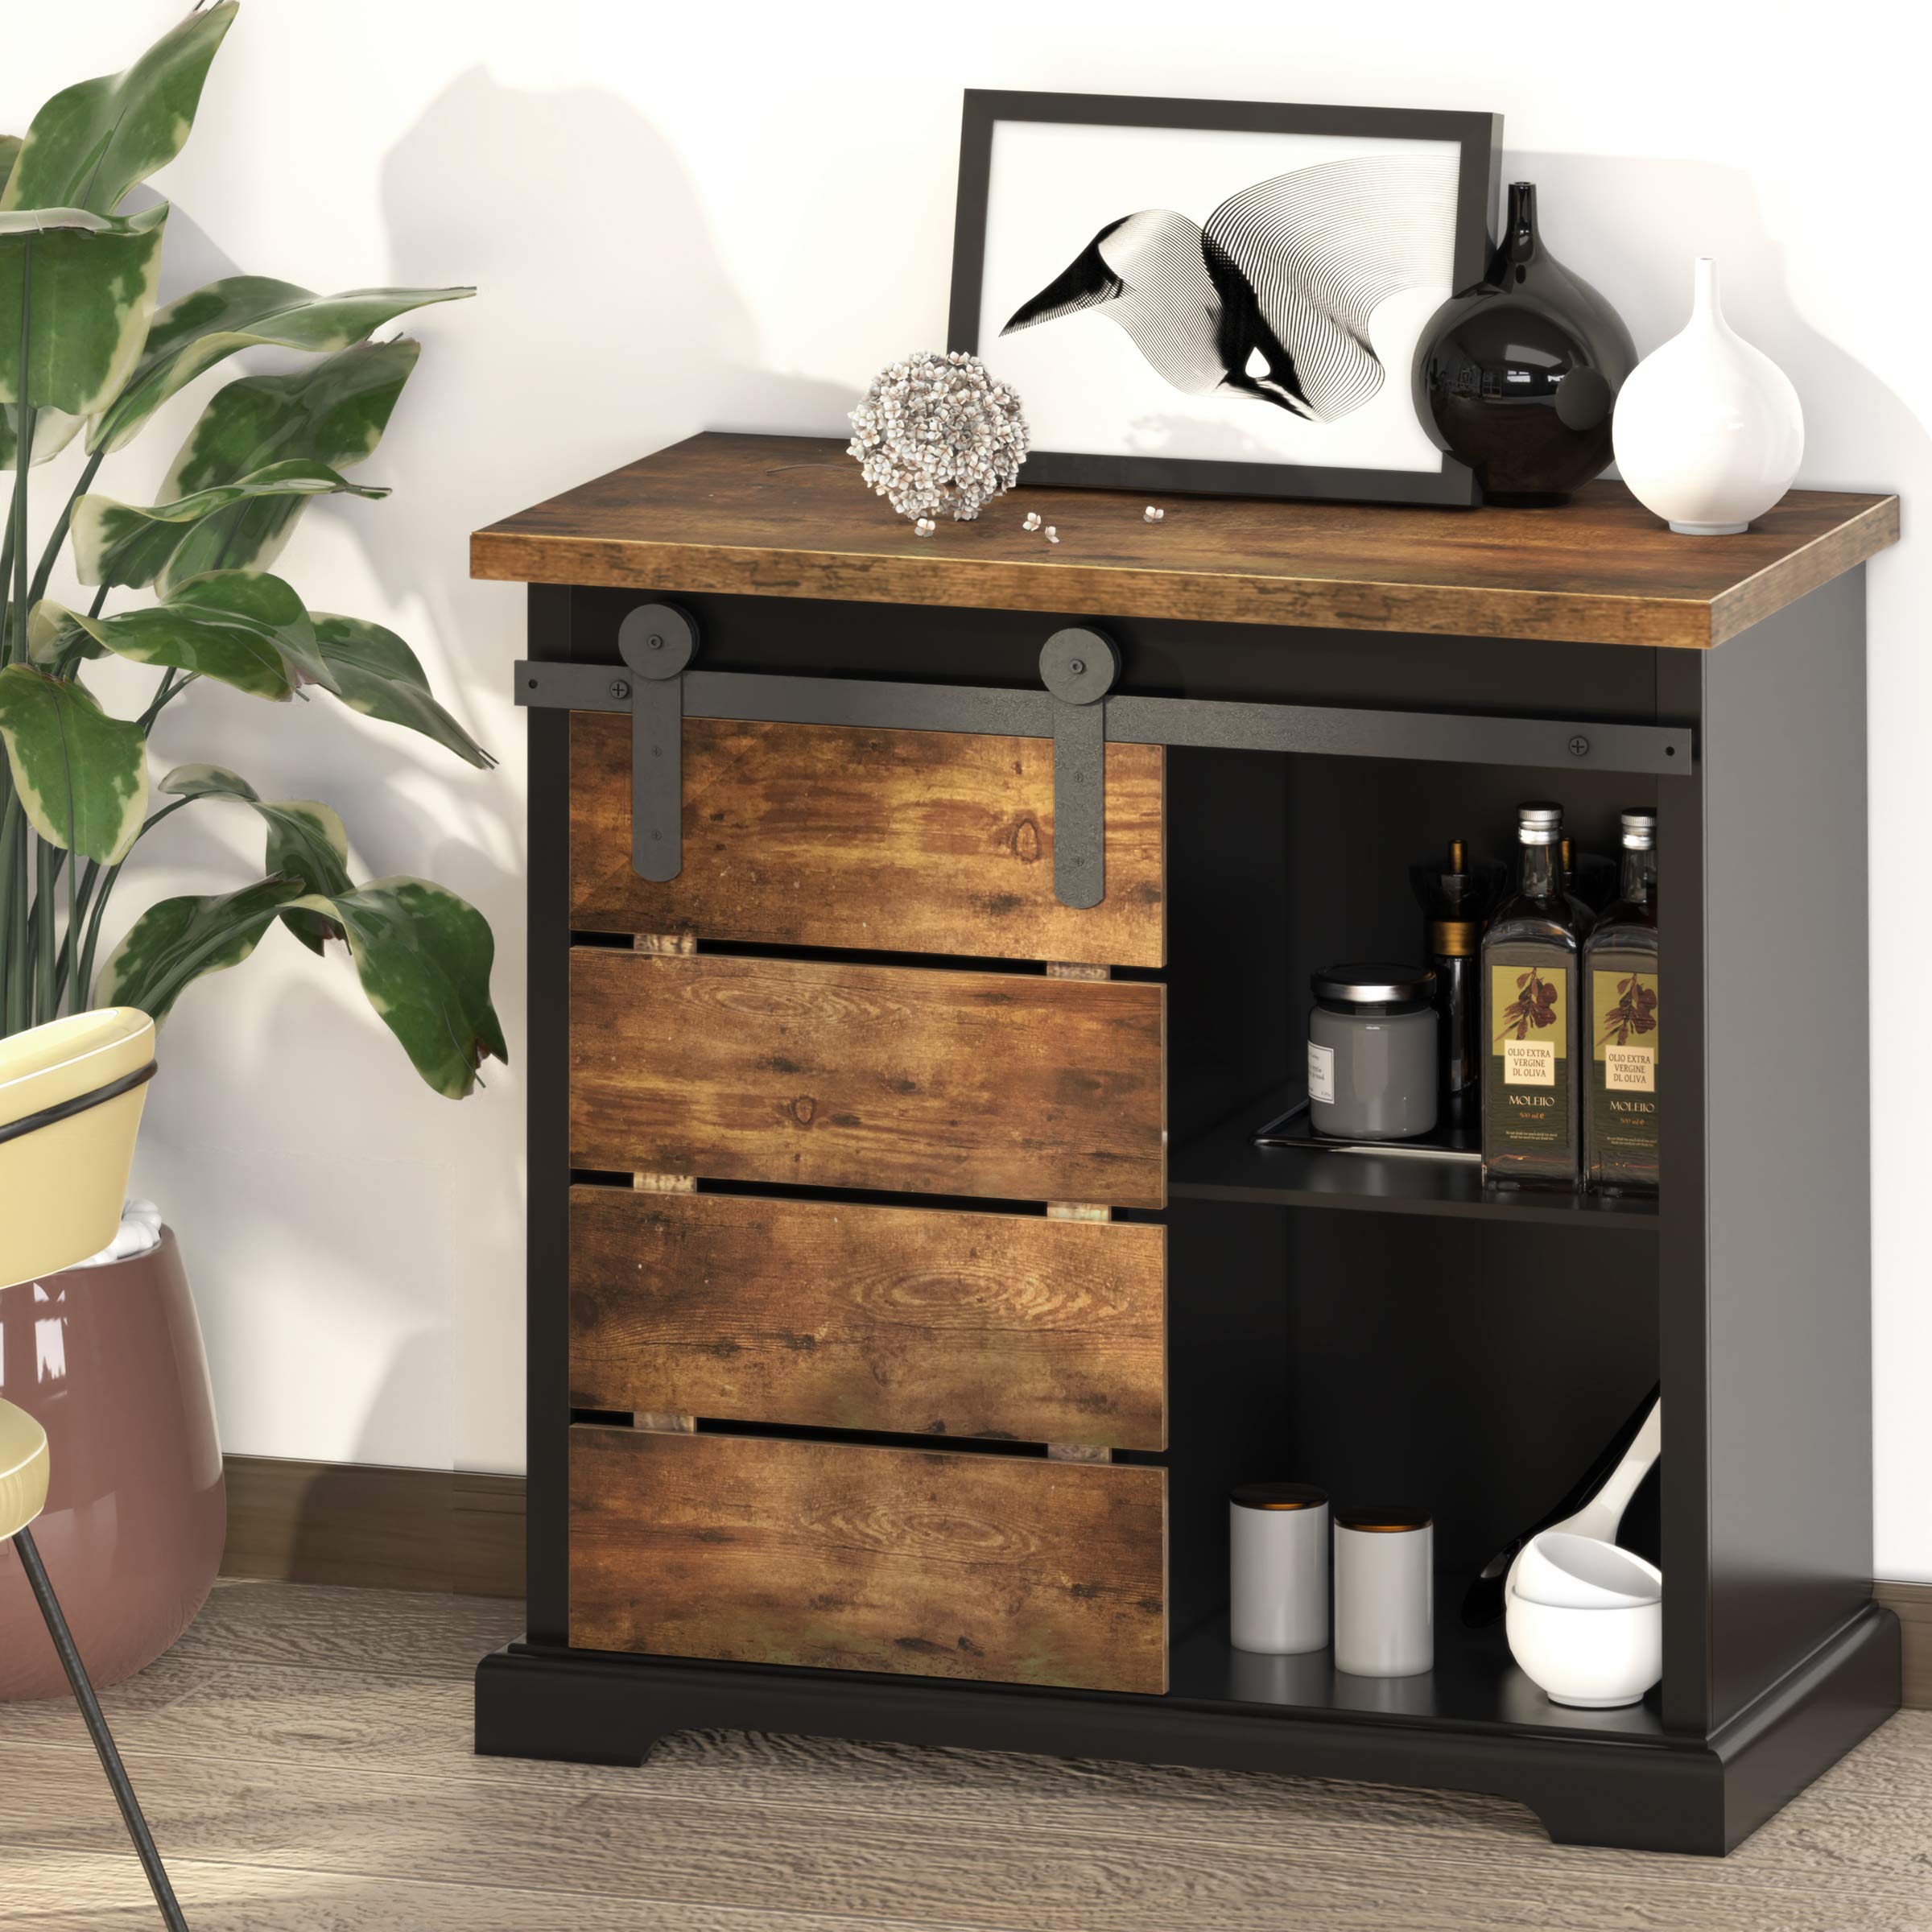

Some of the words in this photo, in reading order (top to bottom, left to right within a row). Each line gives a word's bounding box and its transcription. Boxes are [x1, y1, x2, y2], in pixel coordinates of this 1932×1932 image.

[1508, 1048, 1525, 1057] OLIO
[1526, 1049, 1551, 1058] EXTRA
[1513, 1058, 1546, 1067] VERGINE
[1608, 1053, 1626, 1063] OLIO
[1627, 1055, 1651, 1064] EXTRA
[1523, 1068, 1546, 1077] OLIVA
[1614, 1063, 1645, 1074] VERGINE
[1624, 1074, 1647, 1084] OLIVA
